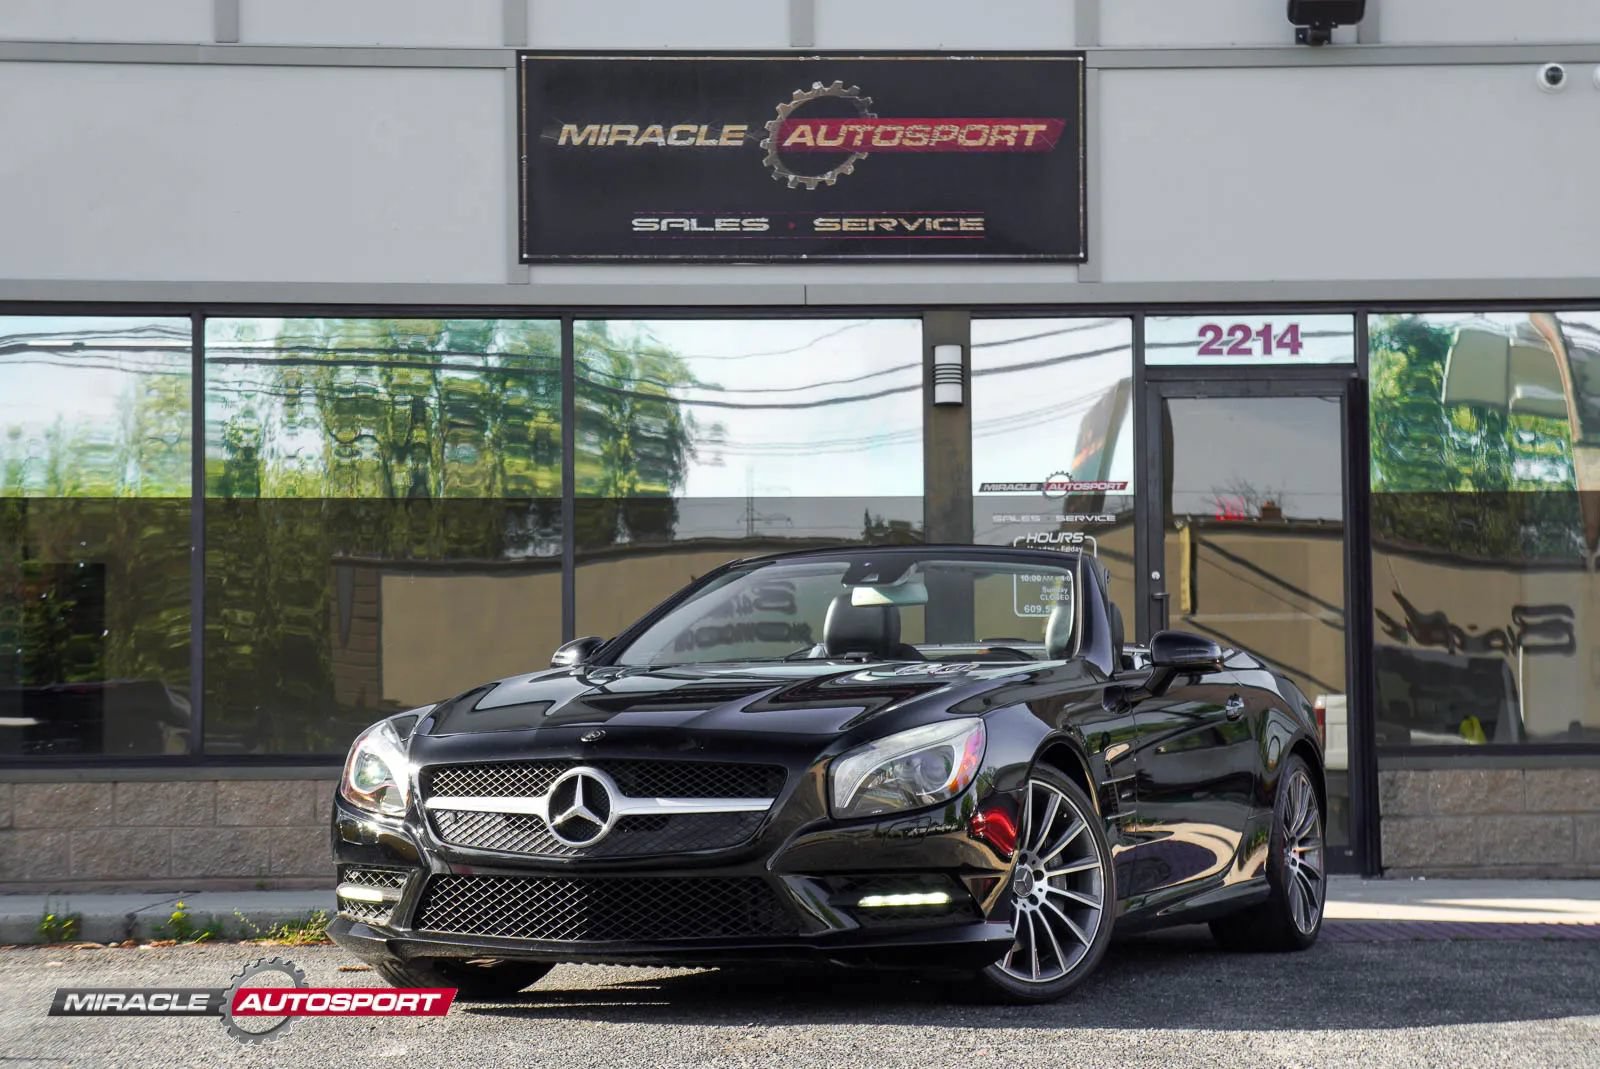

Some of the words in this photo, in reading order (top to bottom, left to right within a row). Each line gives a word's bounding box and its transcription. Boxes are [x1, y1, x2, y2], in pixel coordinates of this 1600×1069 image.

[557, 123, 748, 147] MIRACLE
[782, 122, 1049, 147] AUTOSPORT
[631, 217, 770, 232] SALES
[813, 217, 985, 232] SERVICE
[1197, 323, 1303, 356] 2214
[983, 483, 1038, 491] MIRACLE
[1048, 482, 1125, 491] AUTOSPORT
[1026, 532, 1084, 544] HOURS
[1024, 604, 1051, 614] 609.5
